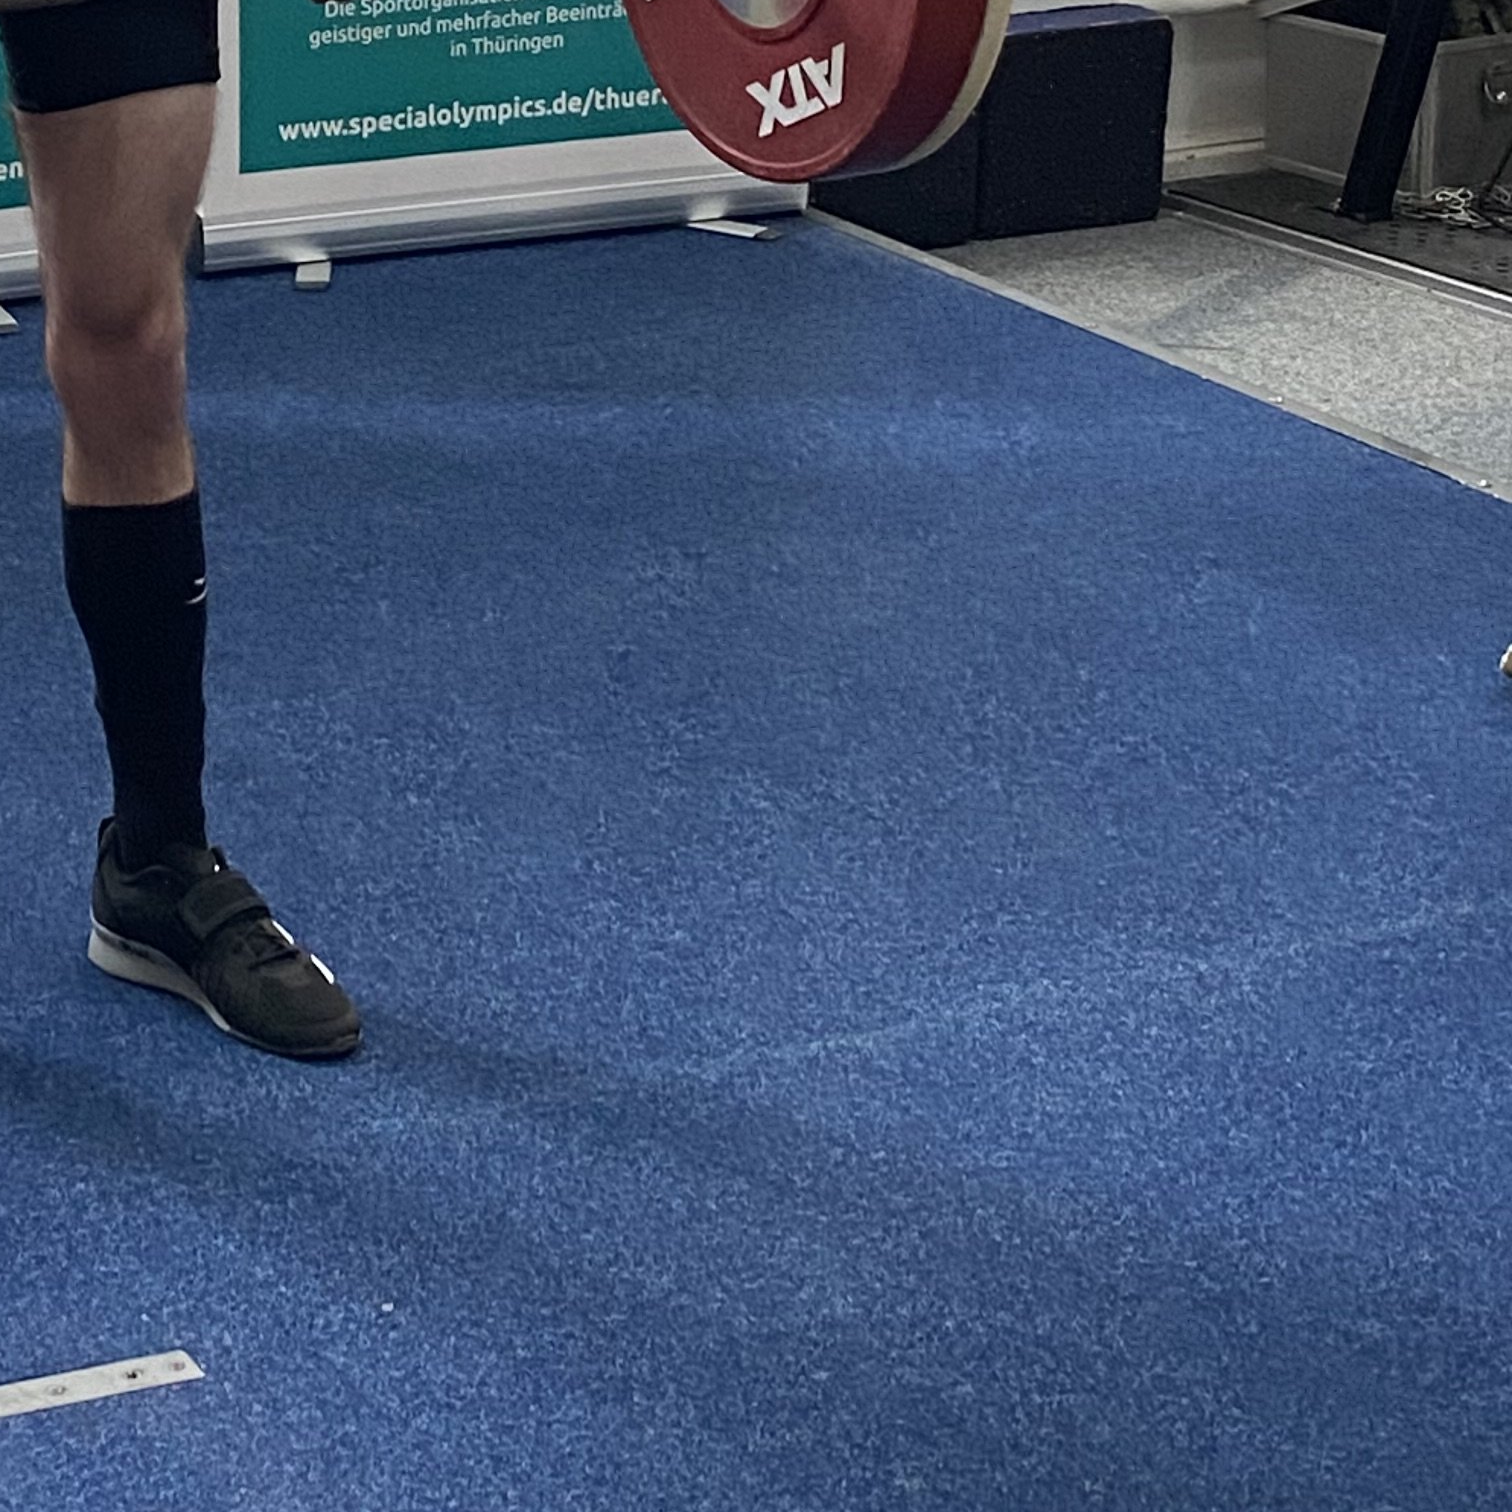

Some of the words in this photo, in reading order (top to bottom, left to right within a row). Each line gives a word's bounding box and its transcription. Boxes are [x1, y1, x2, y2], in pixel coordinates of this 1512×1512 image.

[309, 23, 392, 49] geistiger
[397, 16, 431, 37] und
[436, 8, 540, 33] mehrfacher
[325, 0, 356, 18] Die
[450, 40, 467, 56] in
[472, 33, 563, 56] Thüringen
[745, 42, 846, 138] ATX
[278, 87, 667, 141] www.specialolympics.de/thuer
